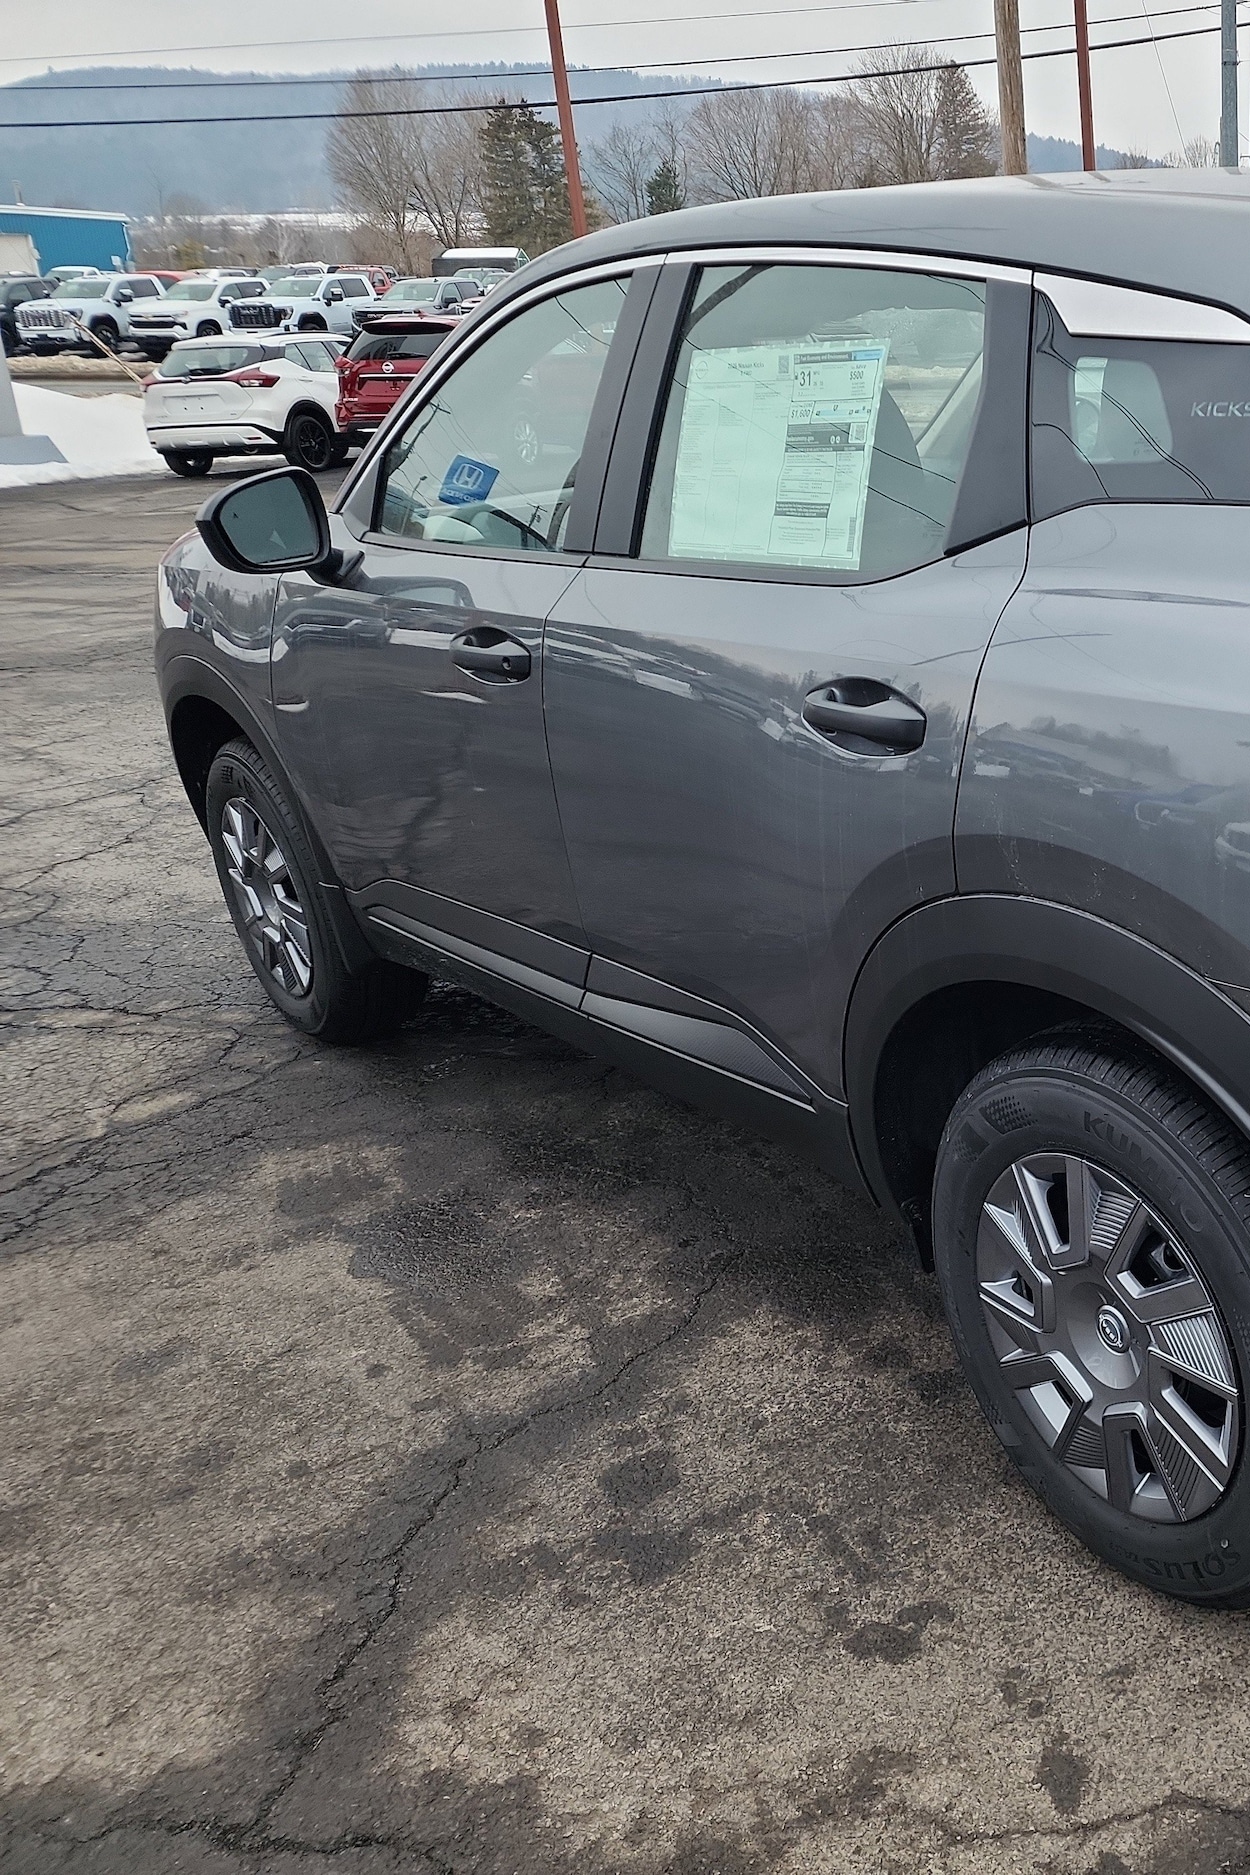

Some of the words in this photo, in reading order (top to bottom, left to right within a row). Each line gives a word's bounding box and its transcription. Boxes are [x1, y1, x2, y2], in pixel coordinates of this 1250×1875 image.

[799, 370, 811, 387] 31
[849, 370, 864, 381] $500
[1142, 1549, 1241, 1580] SOLUS
